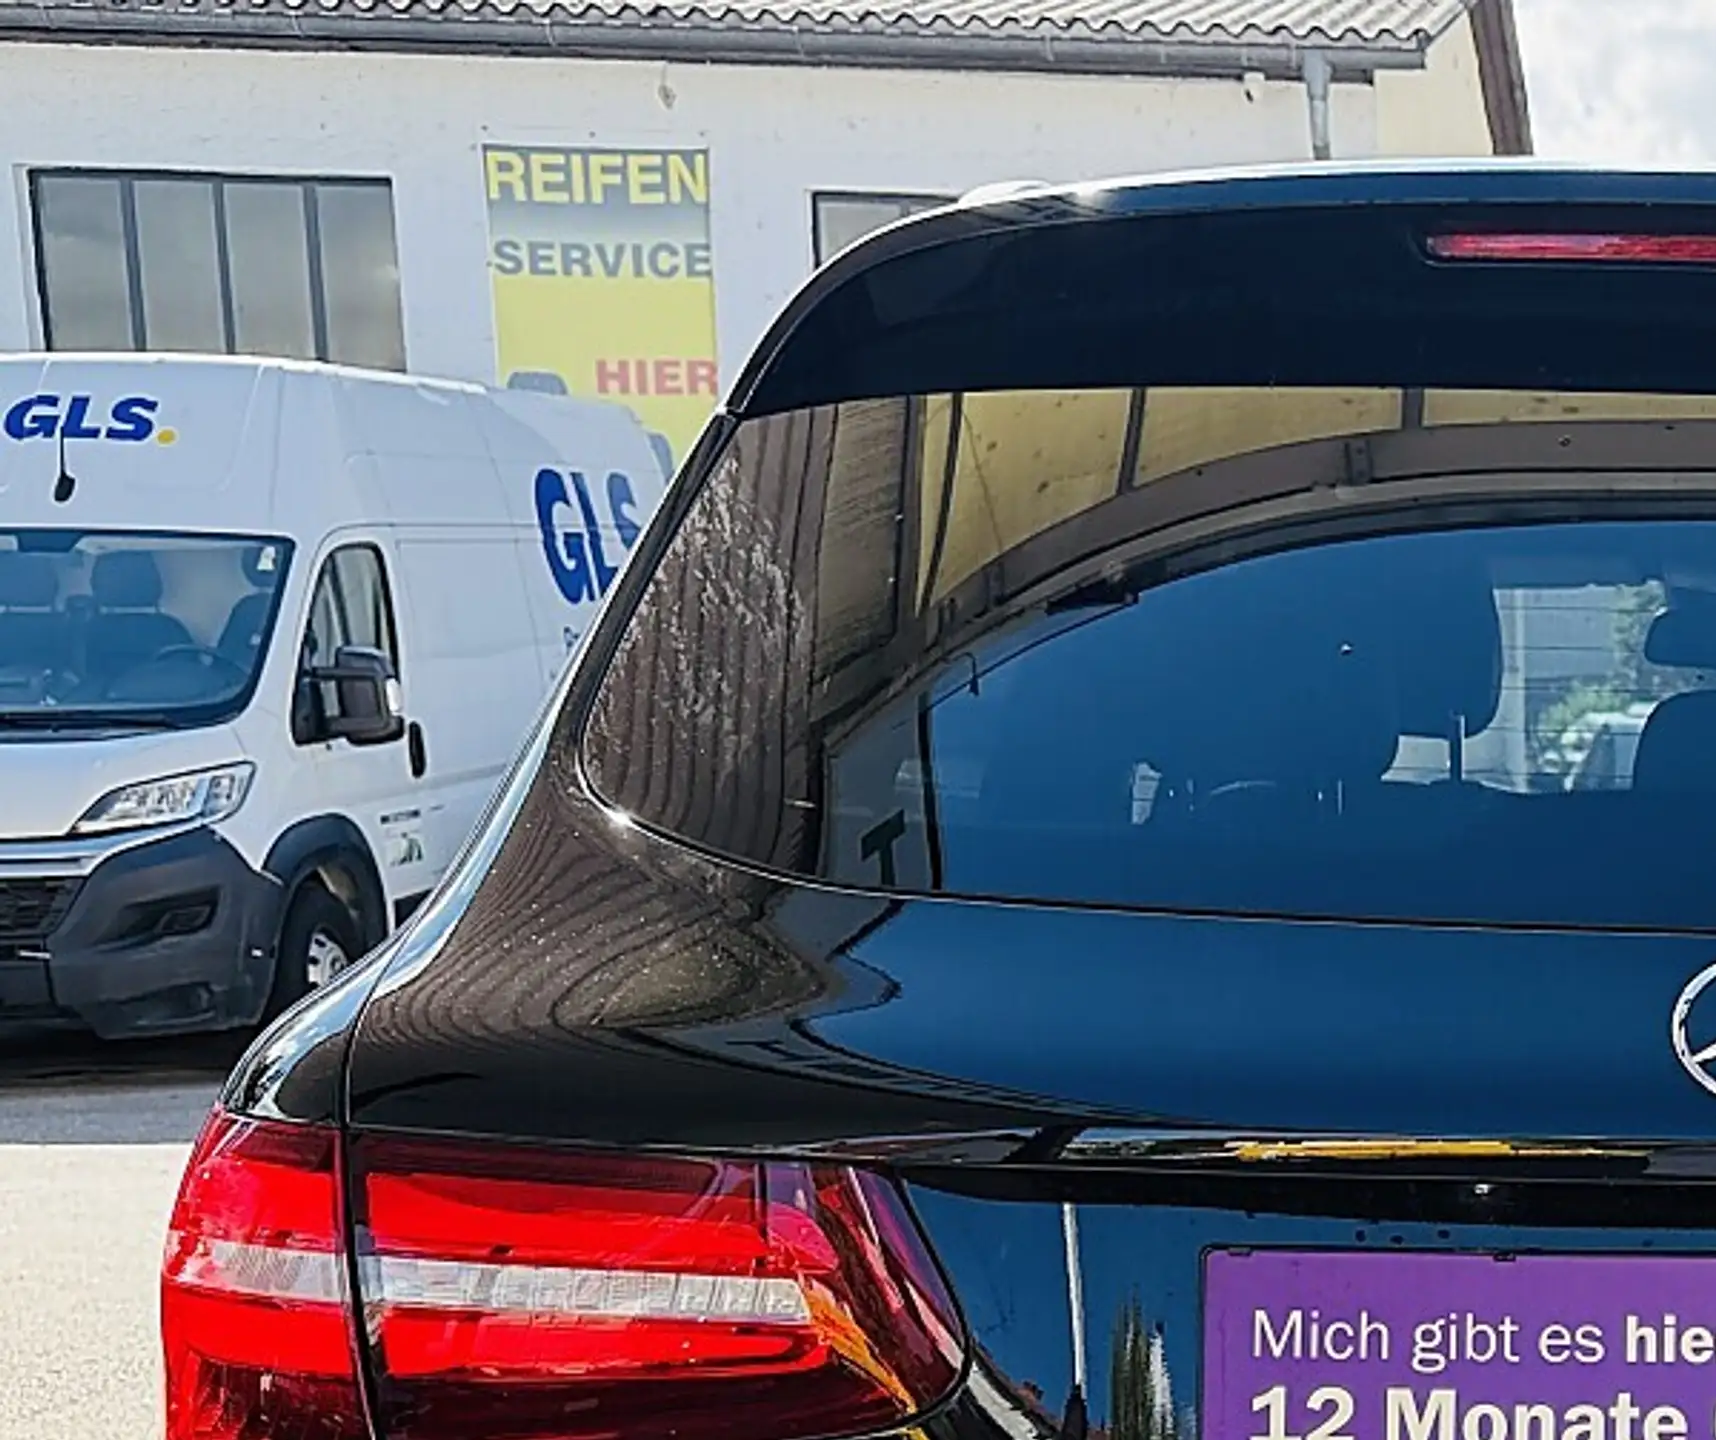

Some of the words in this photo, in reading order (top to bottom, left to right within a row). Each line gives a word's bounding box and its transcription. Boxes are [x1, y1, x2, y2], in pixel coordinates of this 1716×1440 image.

[486, 151, 708, 204] REIFEN
[493, 240, 712, 278] SERVICE
[596, 359, 718, 396] HIER
[1252, 1309, 1391, 1361] Mich
[1412, 1312, 1521, 1373] gibt
[1538, 1323, 1606, 1364] es
